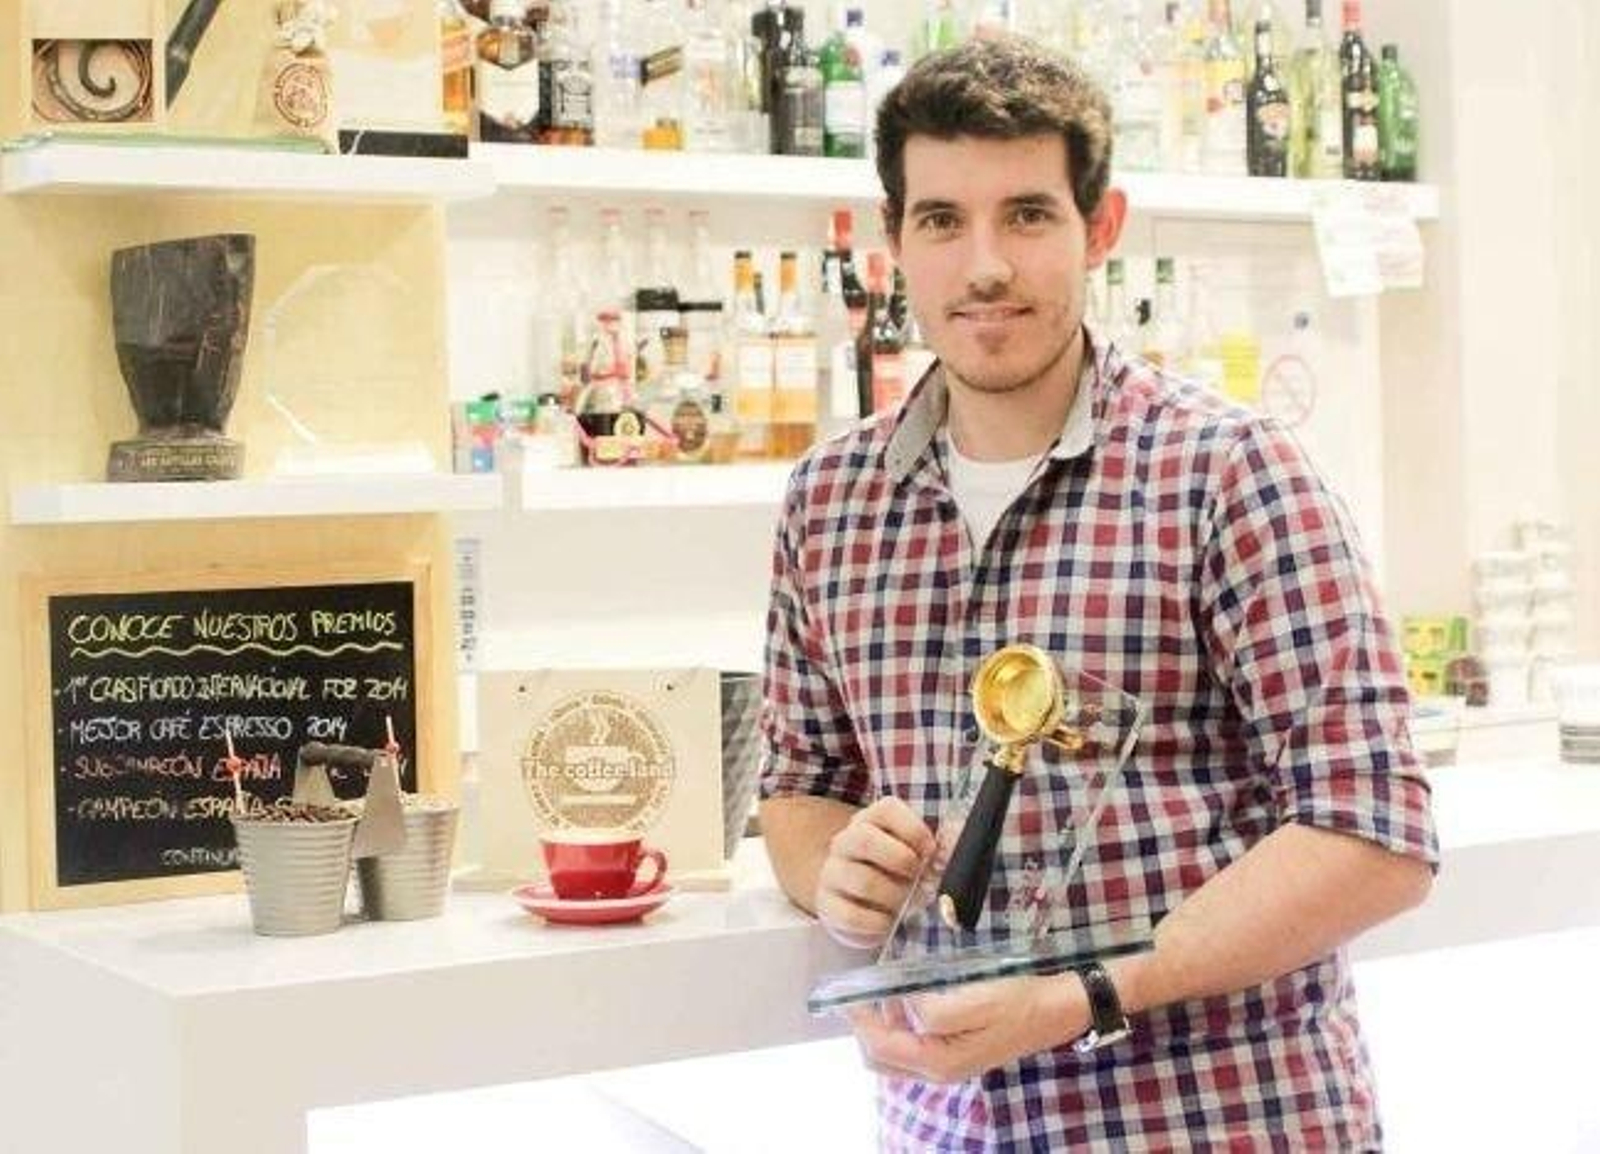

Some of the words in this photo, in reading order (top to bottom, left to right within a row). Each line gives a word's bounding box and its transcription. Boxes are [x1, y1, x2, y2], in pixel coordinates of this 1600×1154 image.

[68, 614, 188, 643] CONOCE
[193, 608, 299, 641] NUESTROS
[311, 610, 396, 637] PREMIOS
[70, 715, 141, 748] MEJOR
[151, 709, 192, 741] CAFÉ
[199, 713, 292, 740] ESPRESSO
[306, 715, 348, 741] 2014
[521, 758, 563, 778] The
